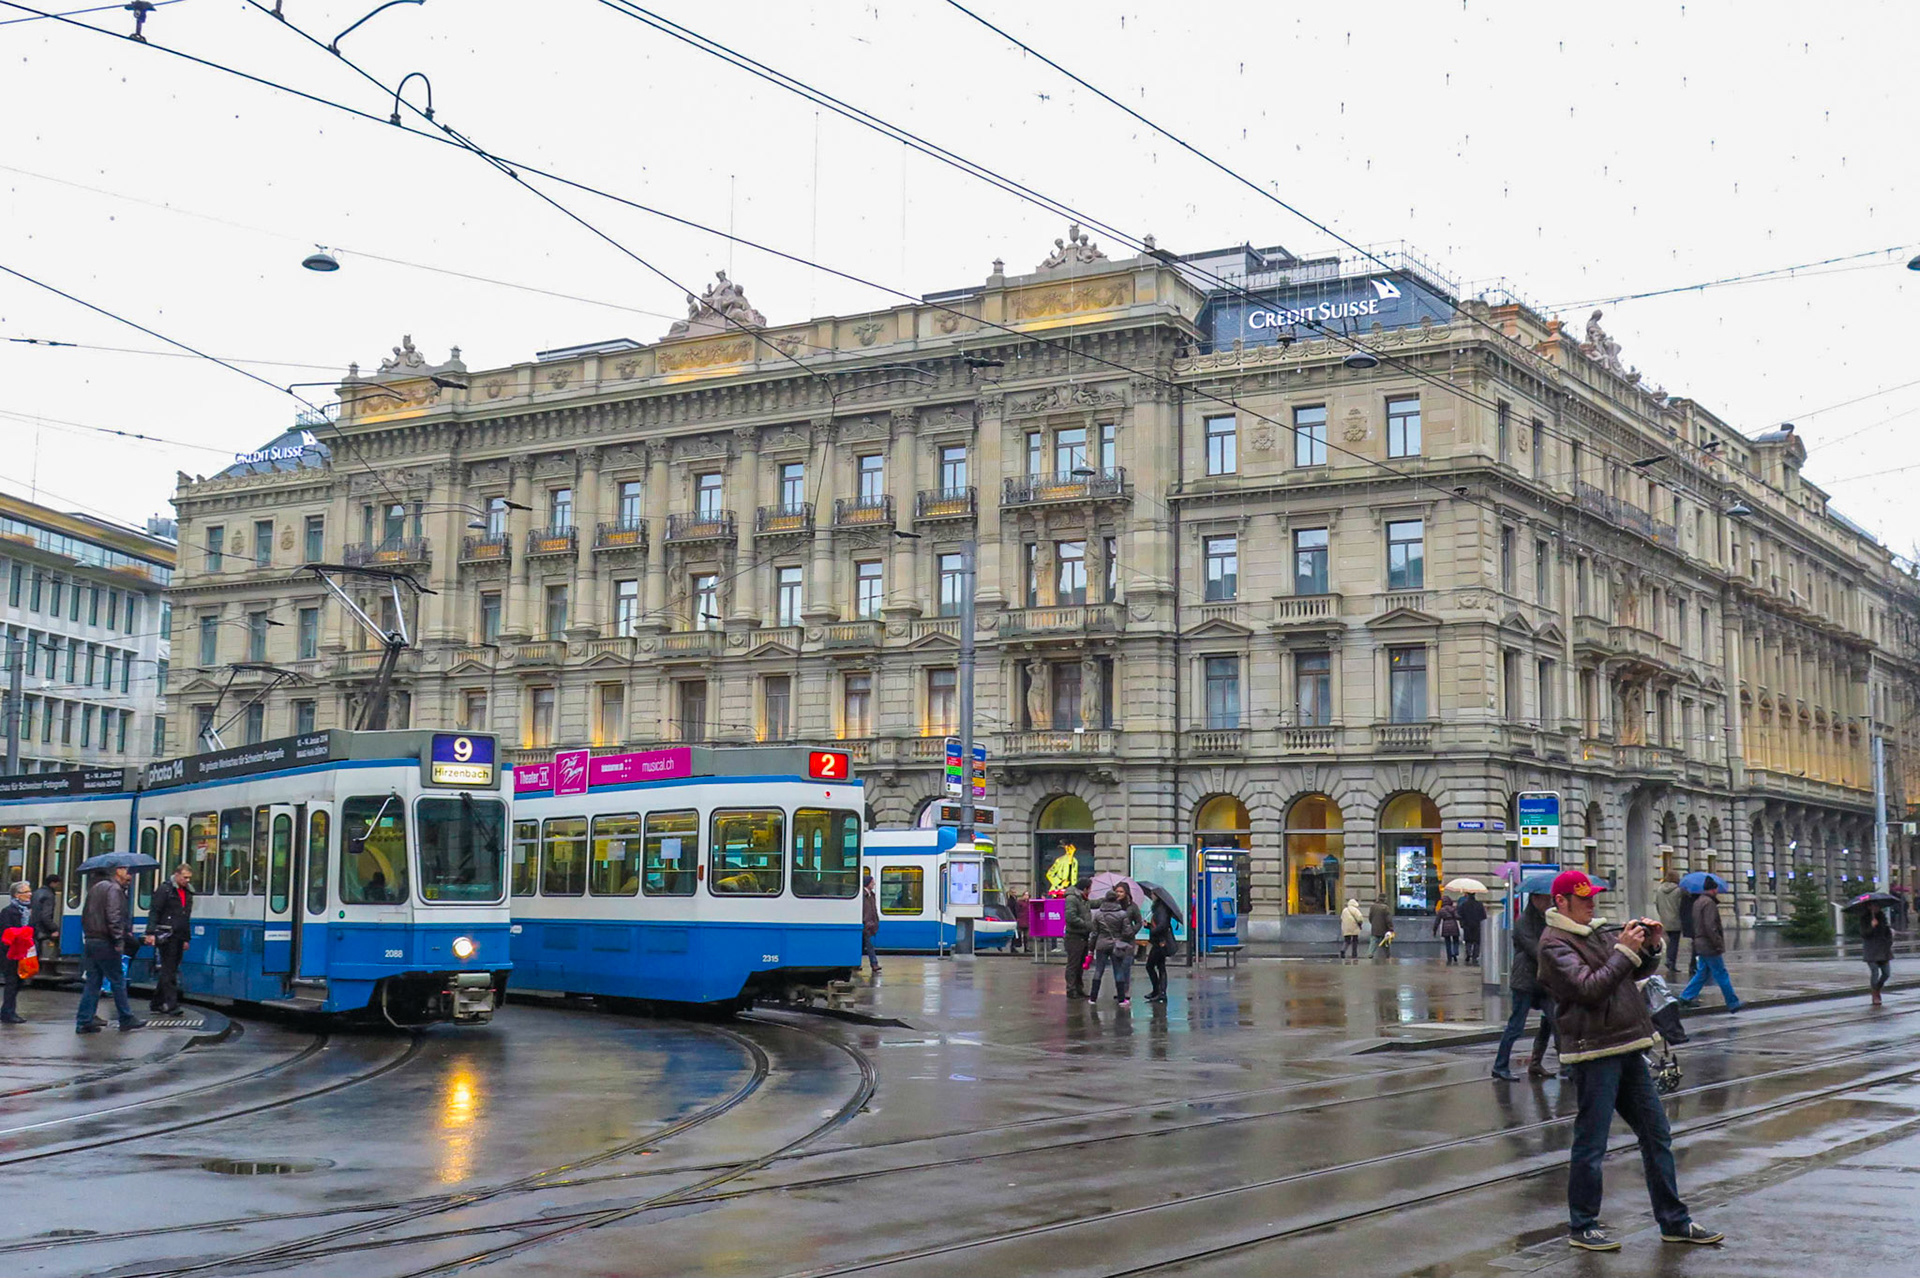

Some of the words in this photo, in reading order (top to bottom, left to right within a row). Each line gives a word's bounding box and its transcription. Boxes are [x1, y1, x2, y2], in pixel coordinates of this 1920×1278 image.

[1248, 306, 1317, 329] CREDIT
[1318, 298, 1379, 320] SUISSE
[270, 445, 304, 460] SUISSE
[453, 736, 473, 762] 9
[641, 756, 675, 773] musical.ch
[820, 753, 836, 776] 2
[148, 764, 173, 787] photo
[172, 759, 184, 779] 14
[433, 767, 490, 779] Hirzenbach
[519, 770, 540, 785] Theater
[384, 950, 404, 958] 2088
[761, 954, 780, 962] 2315
